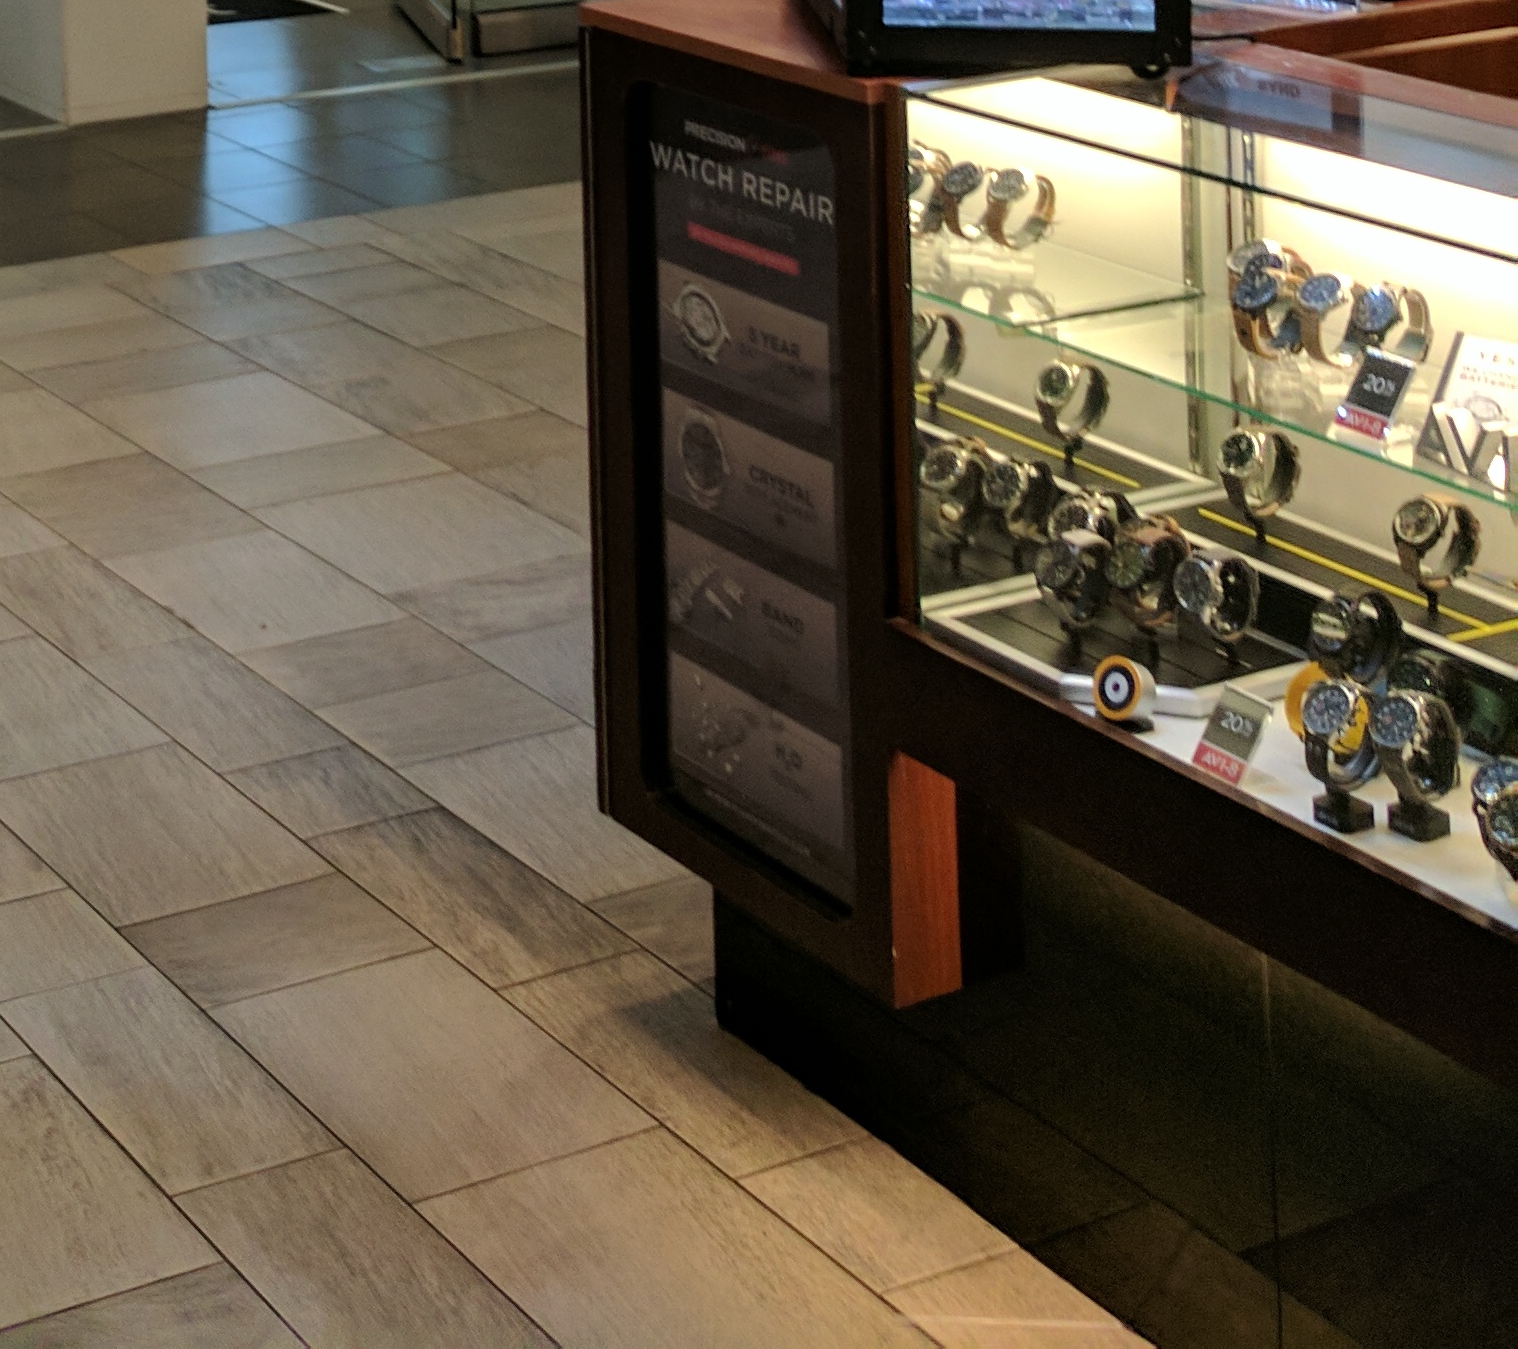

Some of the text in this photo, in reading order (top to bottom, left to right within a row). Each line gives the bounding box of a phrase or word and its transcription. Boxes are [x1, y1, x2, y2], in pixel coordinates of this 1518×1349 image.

[649, 140, 734, 193] WATCH
[742, 169, 834, 225] REPAIR
[748, 464, 815, 509] CRYSTAL
